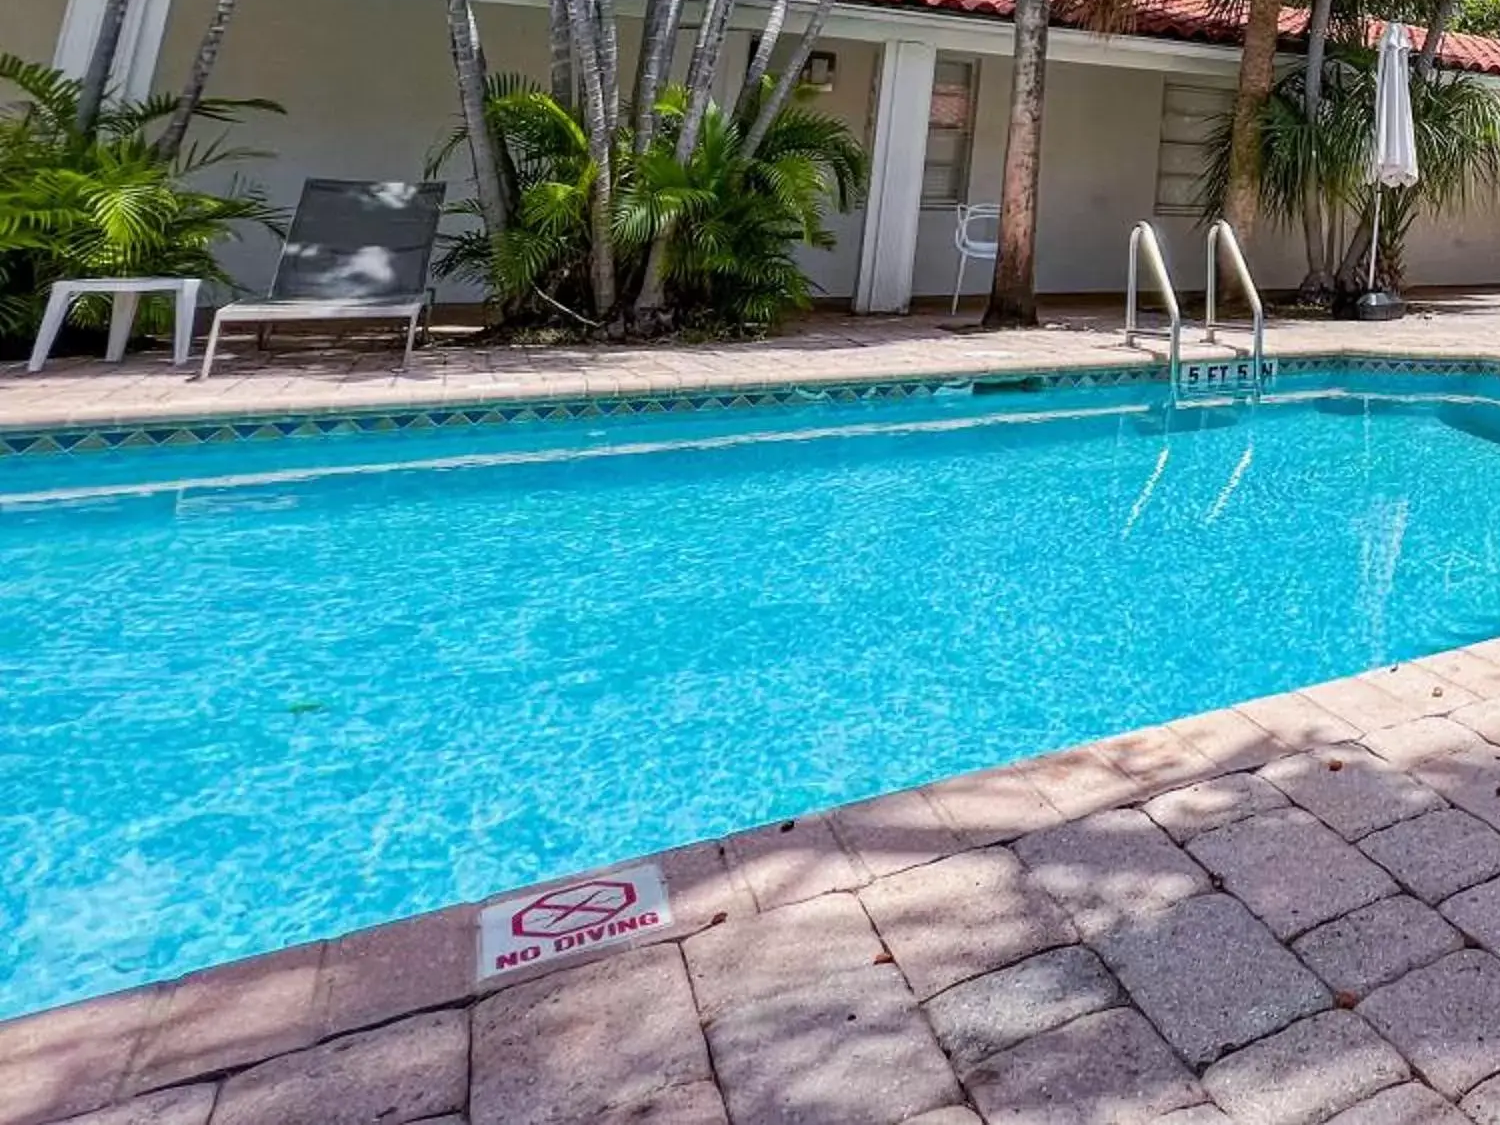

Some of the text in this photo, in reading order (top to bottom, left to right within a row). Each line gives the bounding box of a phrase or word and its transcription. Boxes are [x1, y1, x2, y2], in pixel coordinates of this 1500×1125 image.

[1189, 365, 1199, 382] 5
[1207, 365, 1228, 382] FT
[496, 912, 658, 969] NO DIVING
